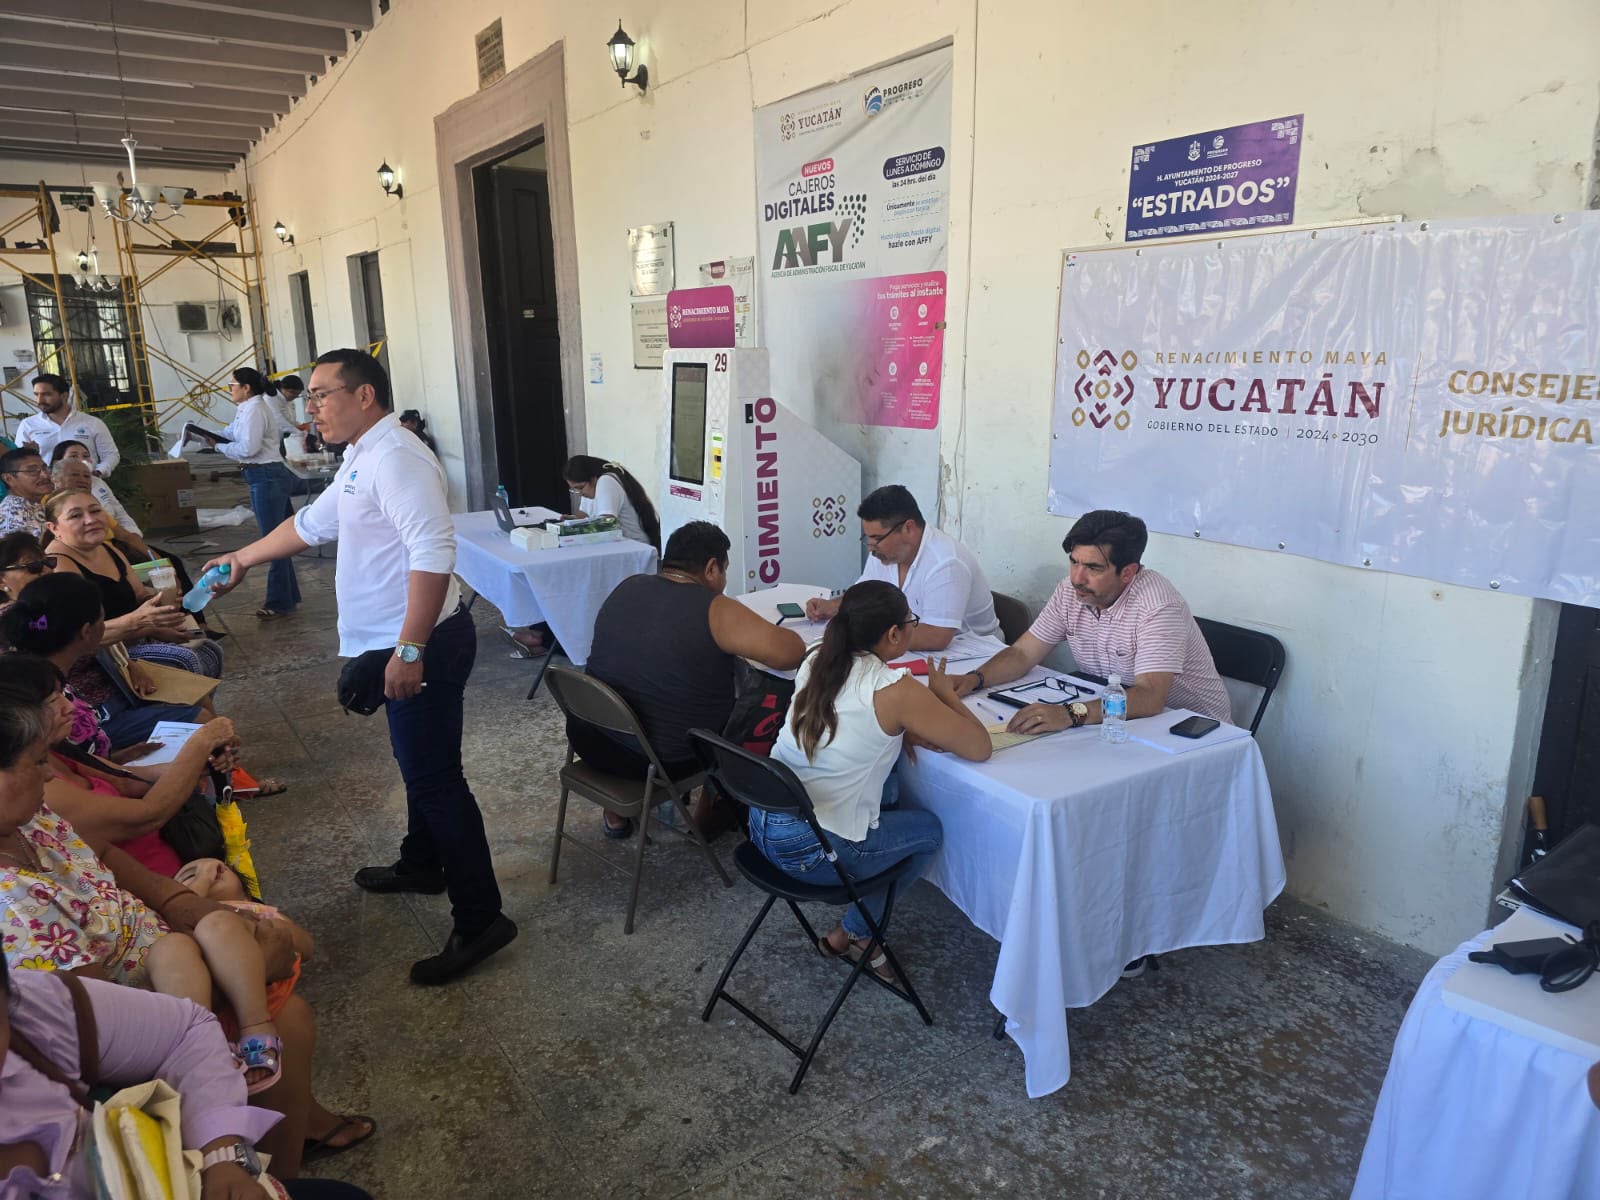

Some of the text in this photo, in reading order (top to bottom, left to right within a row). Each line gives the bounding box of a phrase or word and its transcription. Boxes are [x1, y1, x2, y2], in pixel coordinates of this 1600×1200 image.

[883, 78, 923, 98] PROGRESO
[798, 107, 842, 130] YUCATÁN
[803, 160, 832, 176] NUEVOS
[886, 158, 942, 177] LUNES A DOMINGO
[895, 150, 932, 167] SERVICIO DE
[1164, 166, 1213, 181] AYUNTAMIENTO
[1213, 164, 1223, 173] DE
[1223, 159, 1262, 171] PROGRESO
[788, 174, 836, 196] CAJEROS
[907, 176, 917, 185] hrs.
[918, 175, 927, 183] del
[1174, 174, 1204, 187] YUCATÁN
[764, 192, 835, 222] DIGITALES
[886, 200, 915, 212] Únicamente
[888, 234, 933, 249] hazlo con AFFY
[792, 266, 825, 276] ADMINISTRACIÓN
[825, 264, 840, 273] FISCAL
[846, 261, 866, 270] YUCATÁN
[715, 353, 727, 372] 29
[1155, 350, 1387, 365] RENACIMIENTO MAYA
[1152, 372, 1386, 418] YUCATÁN
[1448, 370, 1600, 404] CONSEJE
[1147, 420, 1378, 446] GOBIERNO DEL ESTADO 2024 2030
[1438, 406, 1592, 444] JURÍDICA
[755, 397, 780, 587] CIMIENTO
